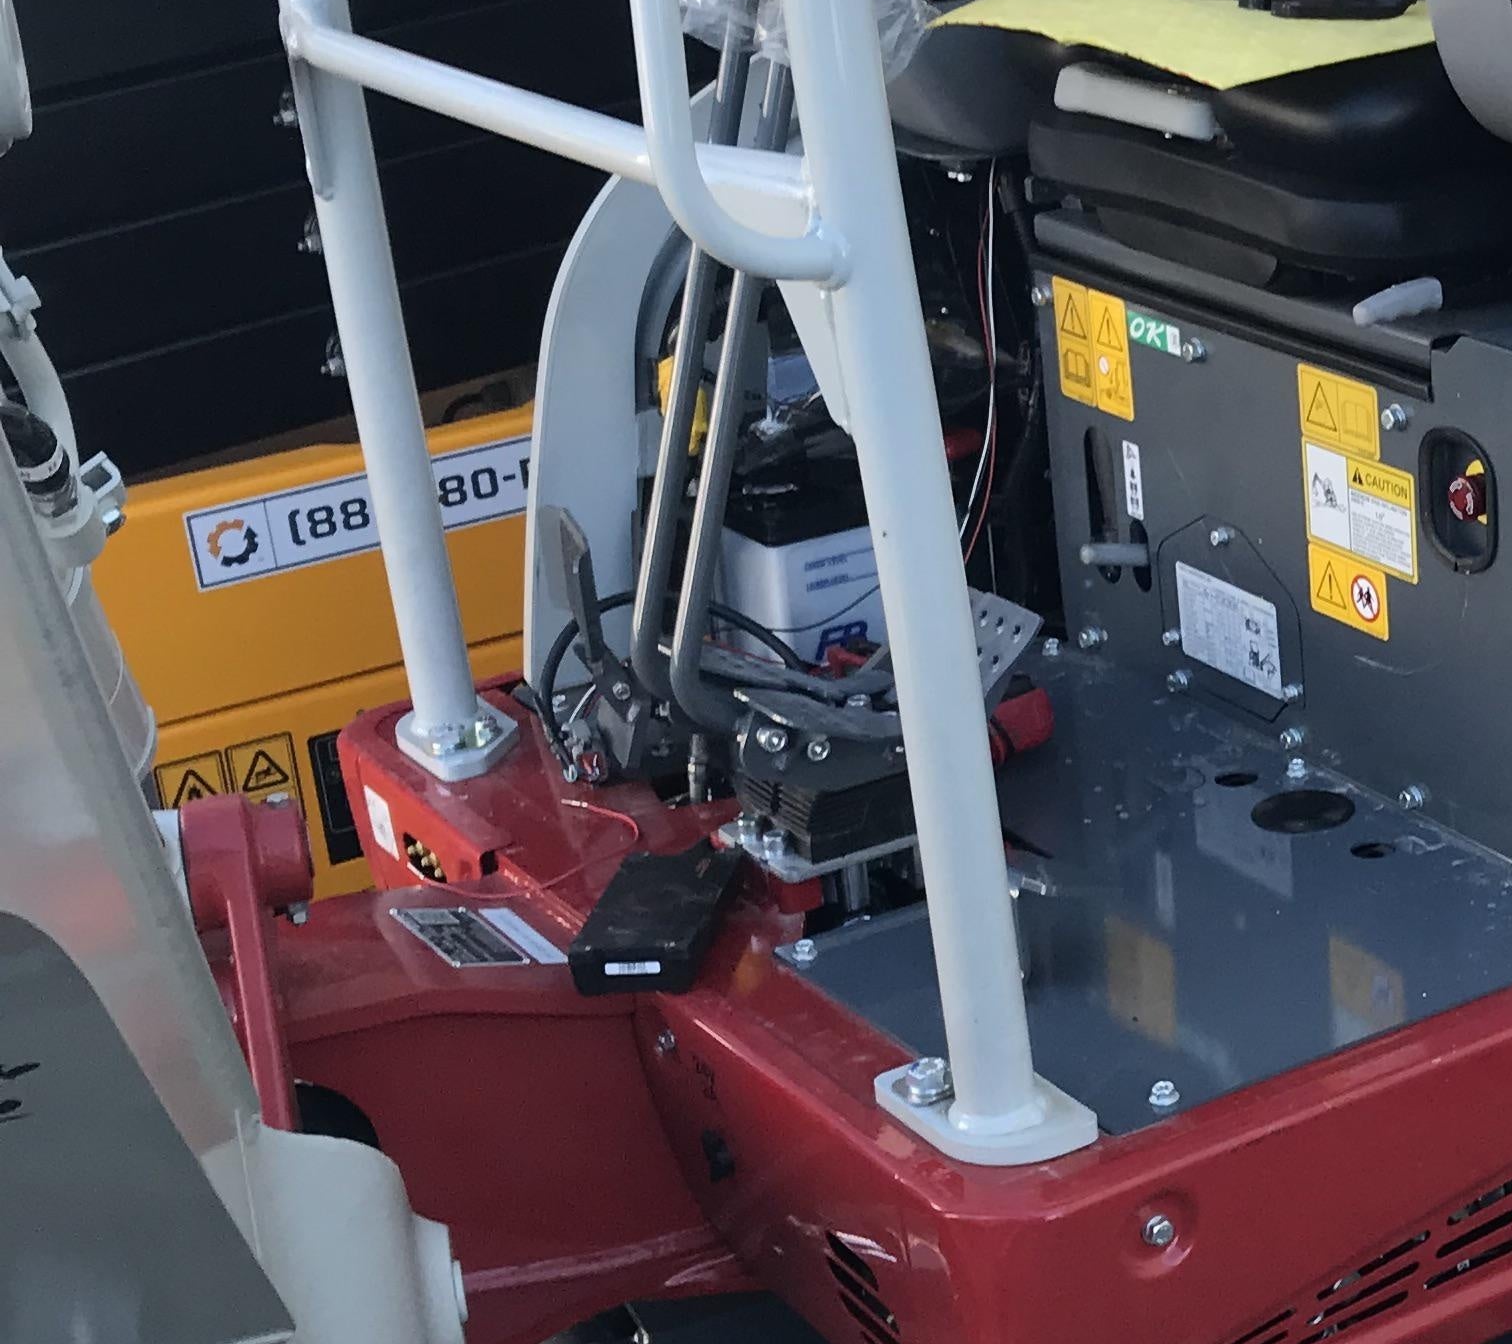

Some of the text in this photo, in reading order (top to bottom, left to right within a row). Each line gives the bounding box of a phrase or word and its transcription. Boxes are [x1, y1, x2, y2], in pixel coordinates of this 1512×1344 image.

[1130, 317, 1165, 348] OK
[1365, 472, 1408, 500] CAUTION
[287, 497, 370, 546] (88
